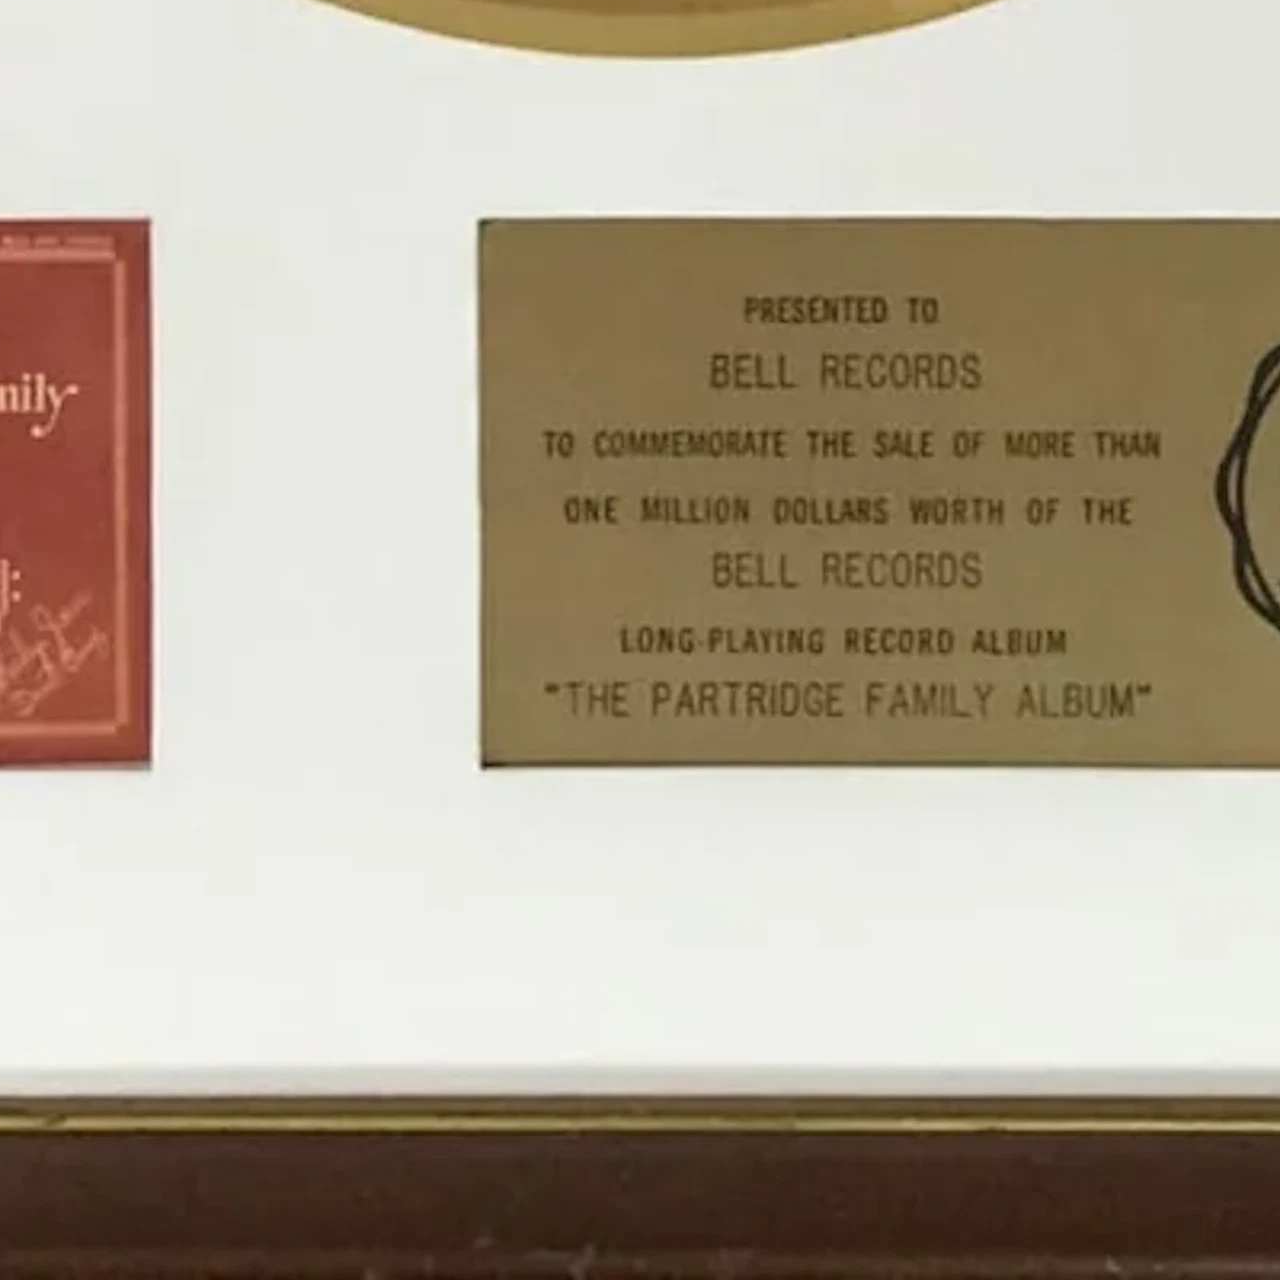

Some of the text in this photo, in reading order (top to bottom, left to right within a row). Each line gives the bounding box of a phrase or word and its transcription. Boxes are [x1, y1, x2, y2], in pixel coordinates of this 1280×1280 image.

[743, 296, 940, 325] PRESENTED TO
[708, 352, 983, 390] BELL RECORDS
[543, 430, 1163, 459] TO COMMEMORATE THE SALE OF MORE THAN
[563, 496, 1133, 526] ONE MILLION DOLLARS WORTH OF THE
[711, 551, 983, 590] BELL RECORDS
[620, 627, 1068, 657] LONG-PLAYING RECORD ALBUM
[651, 681, 844, 719] PARTRIDGE
[866, 681, 998, 719] FAMILY
